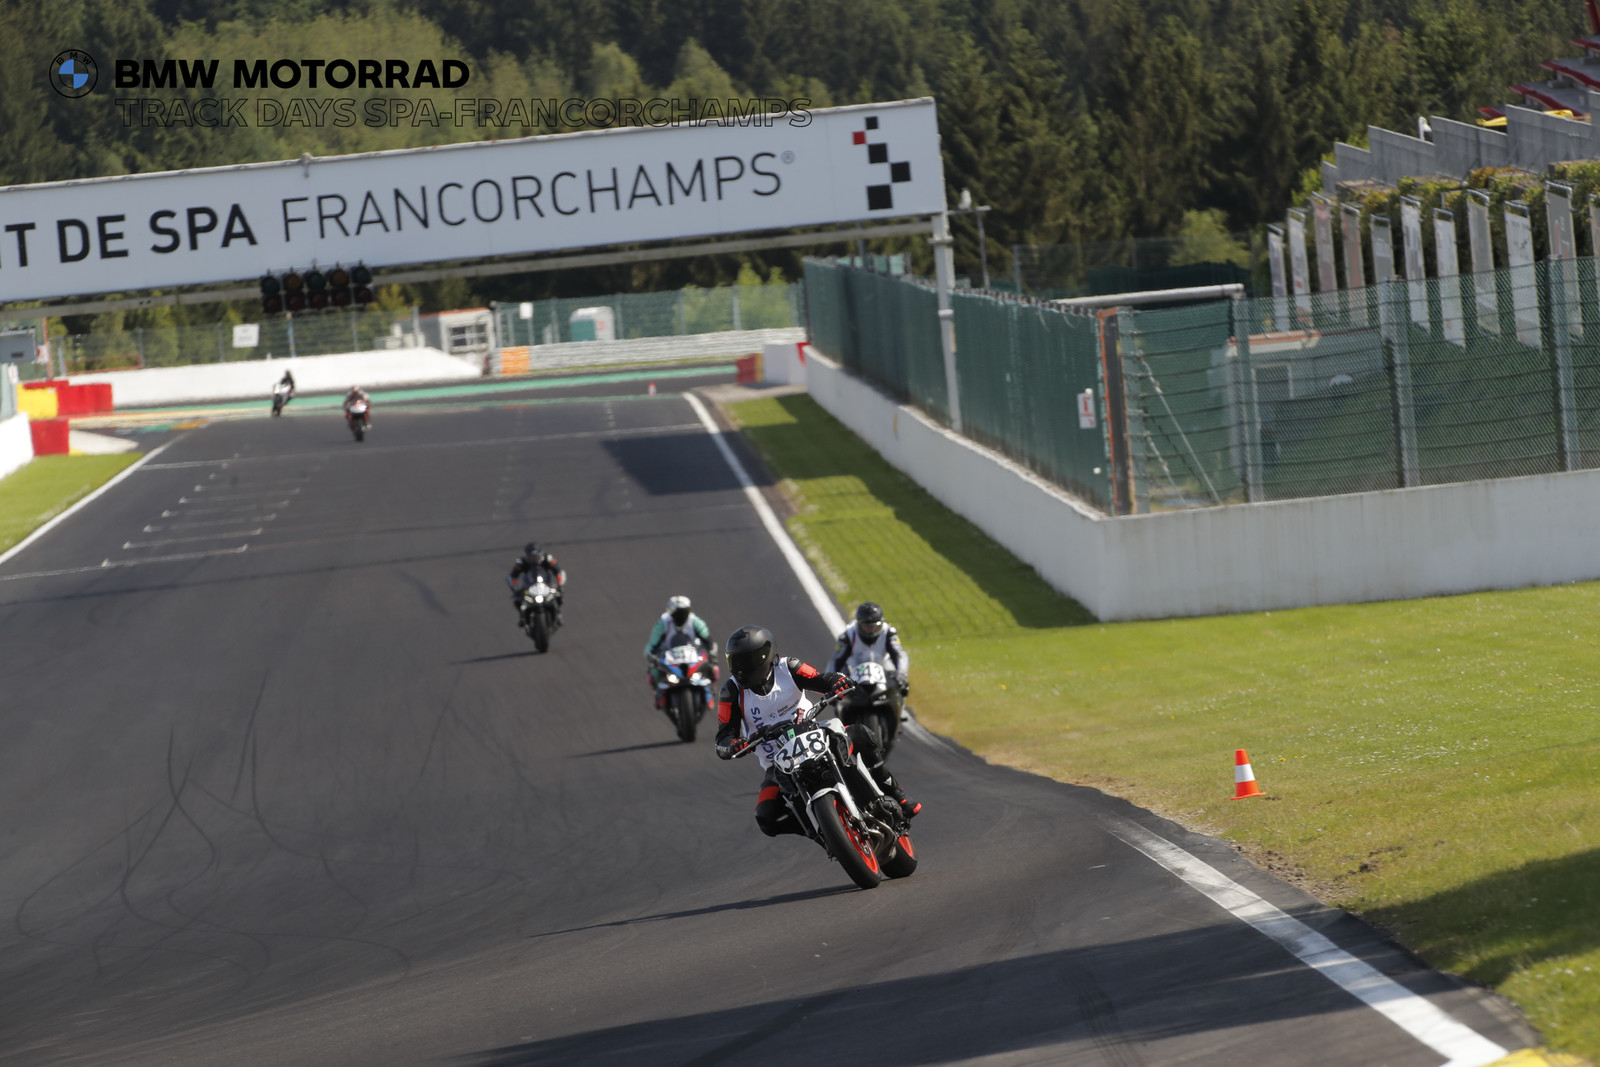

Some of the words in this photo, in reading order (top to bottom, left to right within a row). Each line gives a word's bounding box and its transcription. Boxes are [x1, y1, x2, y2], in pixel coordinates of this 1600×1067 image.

[0, 222, 36, 269] T
[57, 214, 129, 263] DE
[149, 203, 258, 254] SPA
[281, 152, 782, 242] FRANCORCHAMPS
[776, 731, 827, 773] 348
